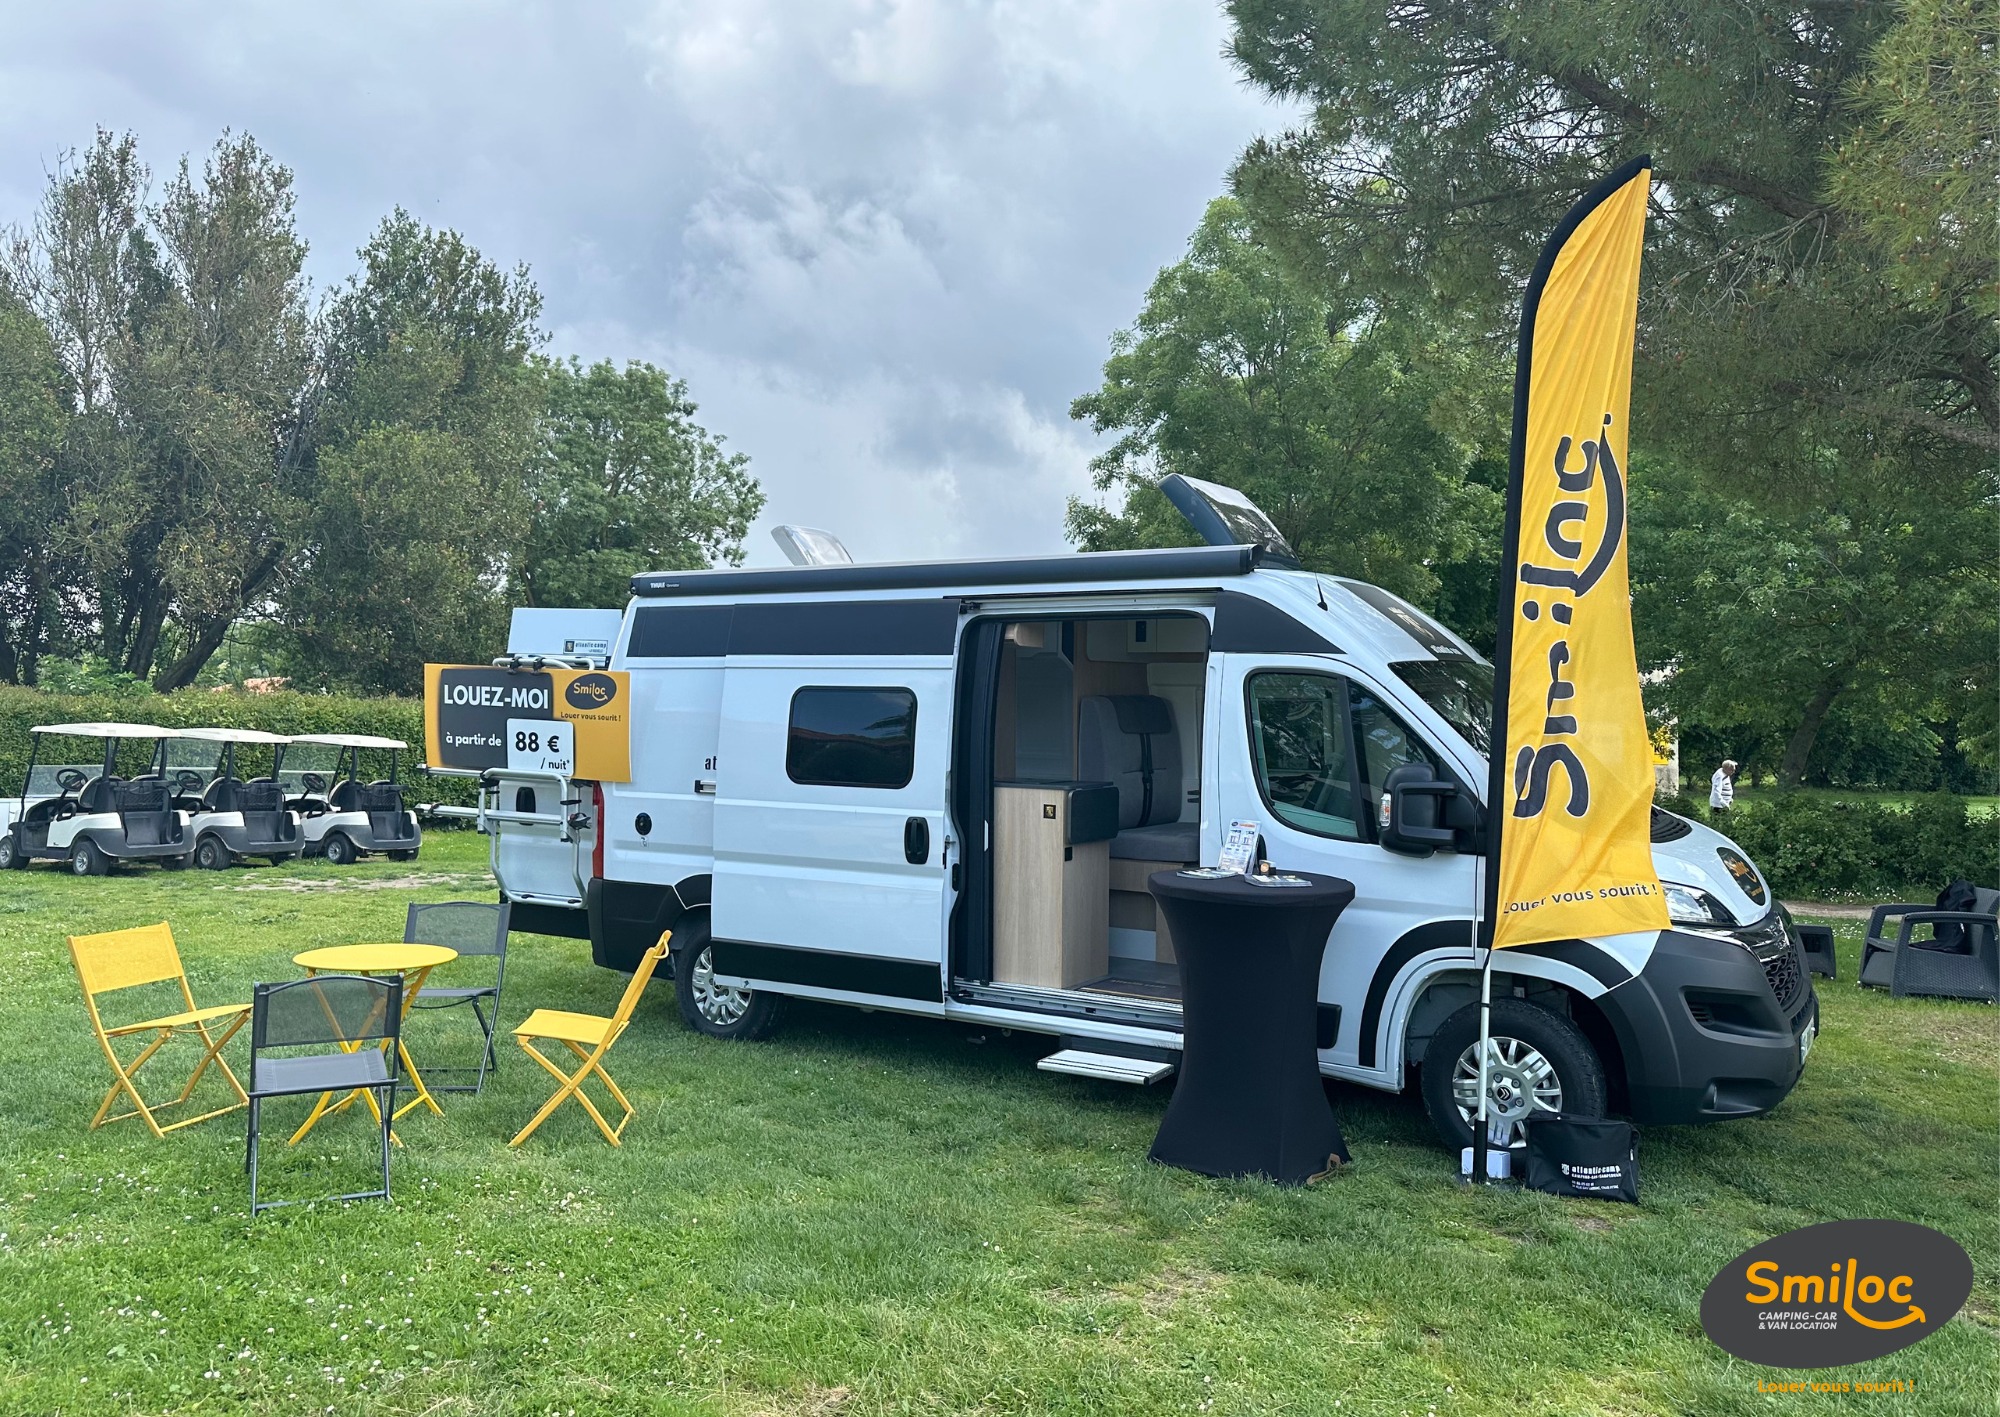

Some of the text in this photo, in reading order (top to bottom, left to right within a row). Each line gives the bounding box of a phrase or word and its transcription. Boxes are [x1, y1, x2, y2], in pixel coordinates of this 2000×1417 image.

[444, 684, 549, 709] LOUEZ-MOI
[573, 682, 609, 702] Smiloc
[560, 712, 580, 720] Louer
[597, 713, 617, 722] sourit
[446, 732, 502, 748] à partir de
[515, 731, 560, 753] 88 €
[1504, 883, 1658, 914] Louer vous sourit !
